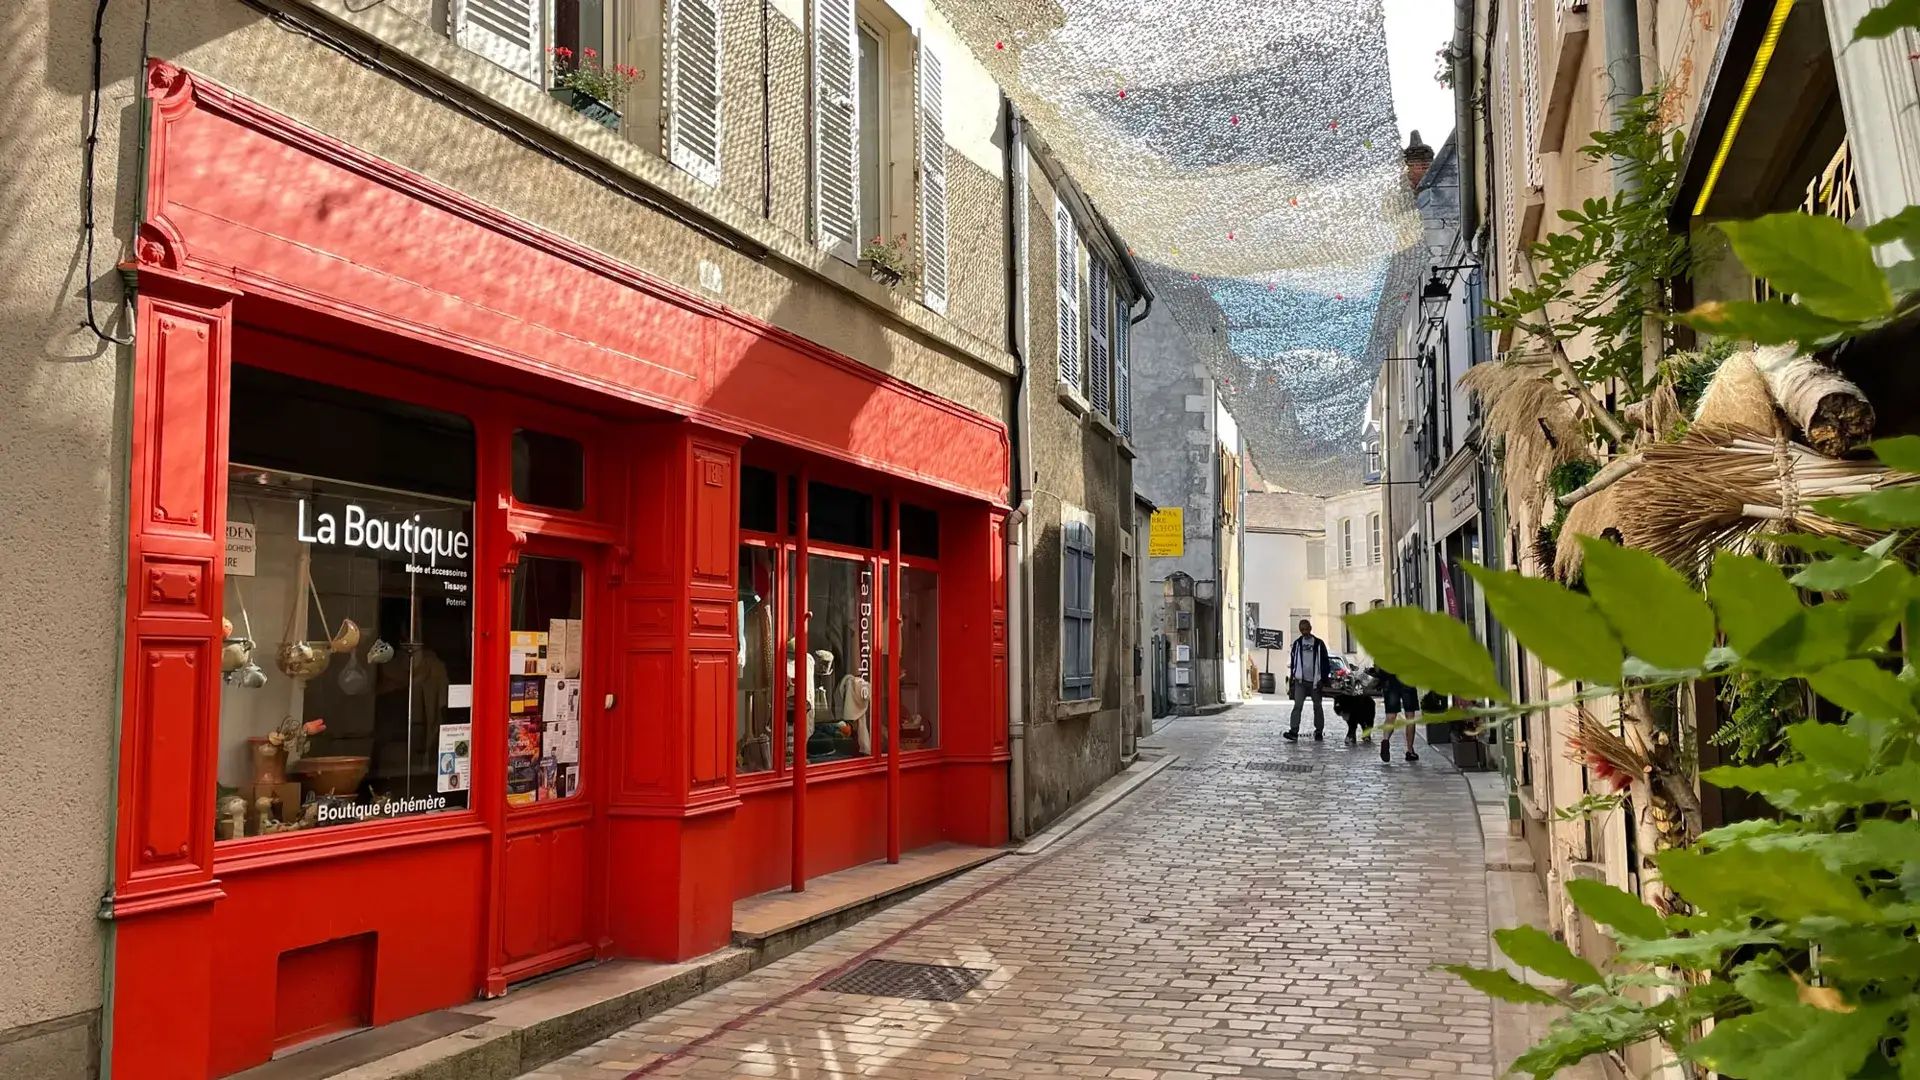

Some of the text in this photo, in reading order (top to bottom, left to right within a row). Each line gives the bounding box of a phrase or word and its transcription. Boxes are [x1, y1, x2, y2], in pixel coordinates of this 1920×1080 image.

[298, 499, 469, 567] La Boutique
[405, 563, 467, 578] Mode et accessoires
[443, 581, 467, 592] Tissage
[446, 597, 467, 606] Poterie
[858, 571, 872, 699] La Boutique
[317, 794, 446, 821] Boutique éphémère
